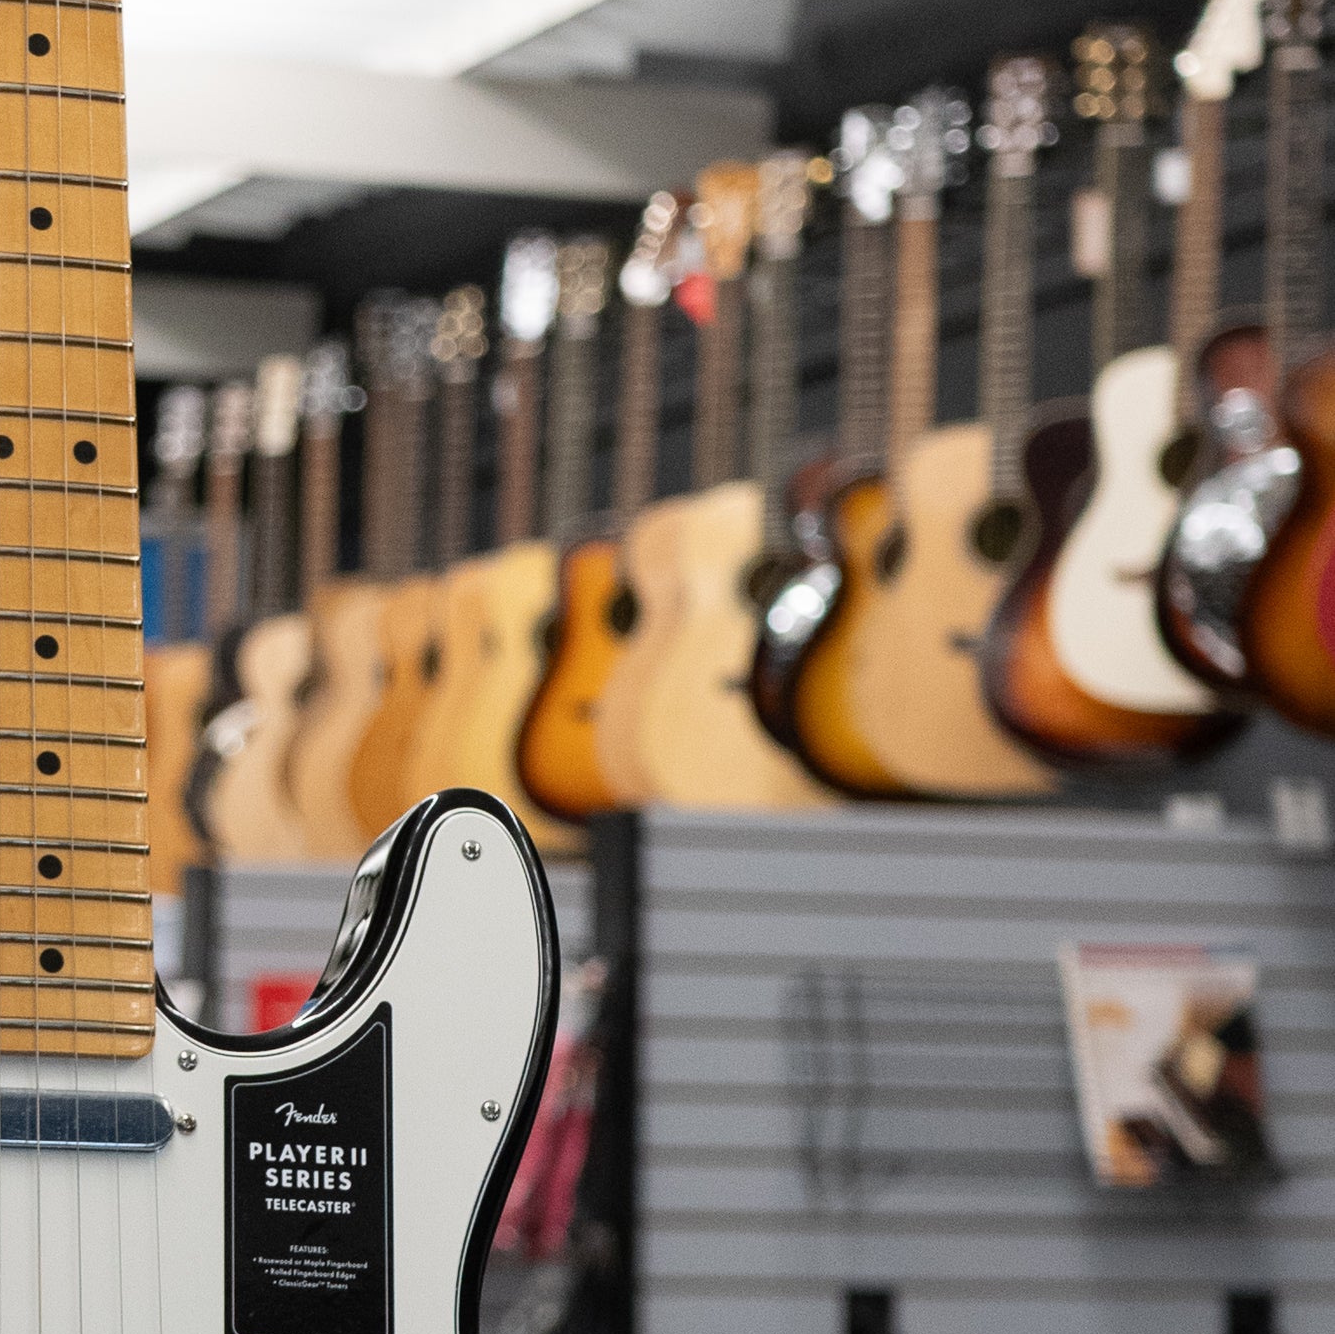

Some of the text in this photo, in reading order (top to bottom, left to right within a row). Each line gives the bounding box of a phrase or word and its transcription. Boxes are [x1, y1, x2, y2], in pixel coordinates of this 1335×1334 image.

[274, 1102, 338, 1127] Fender
[249, 1142, 367, 1166] PLAYER II
[265, 1168, 353, 1191] SERIES
[265, 1197, 352, 1214] TELECASTER
[289, 1244, 329, 1255] FEATURES:
[258, 1256, 293, 1266] Rosewood
[303, 1259, 325, 1268] Maple
[326, 1259, 368, 1269] Fingerboard
[270, 1267, 356, 1280] Rolled Fingerboard Edges
[326, 1281, 348, 1290] Tuners
